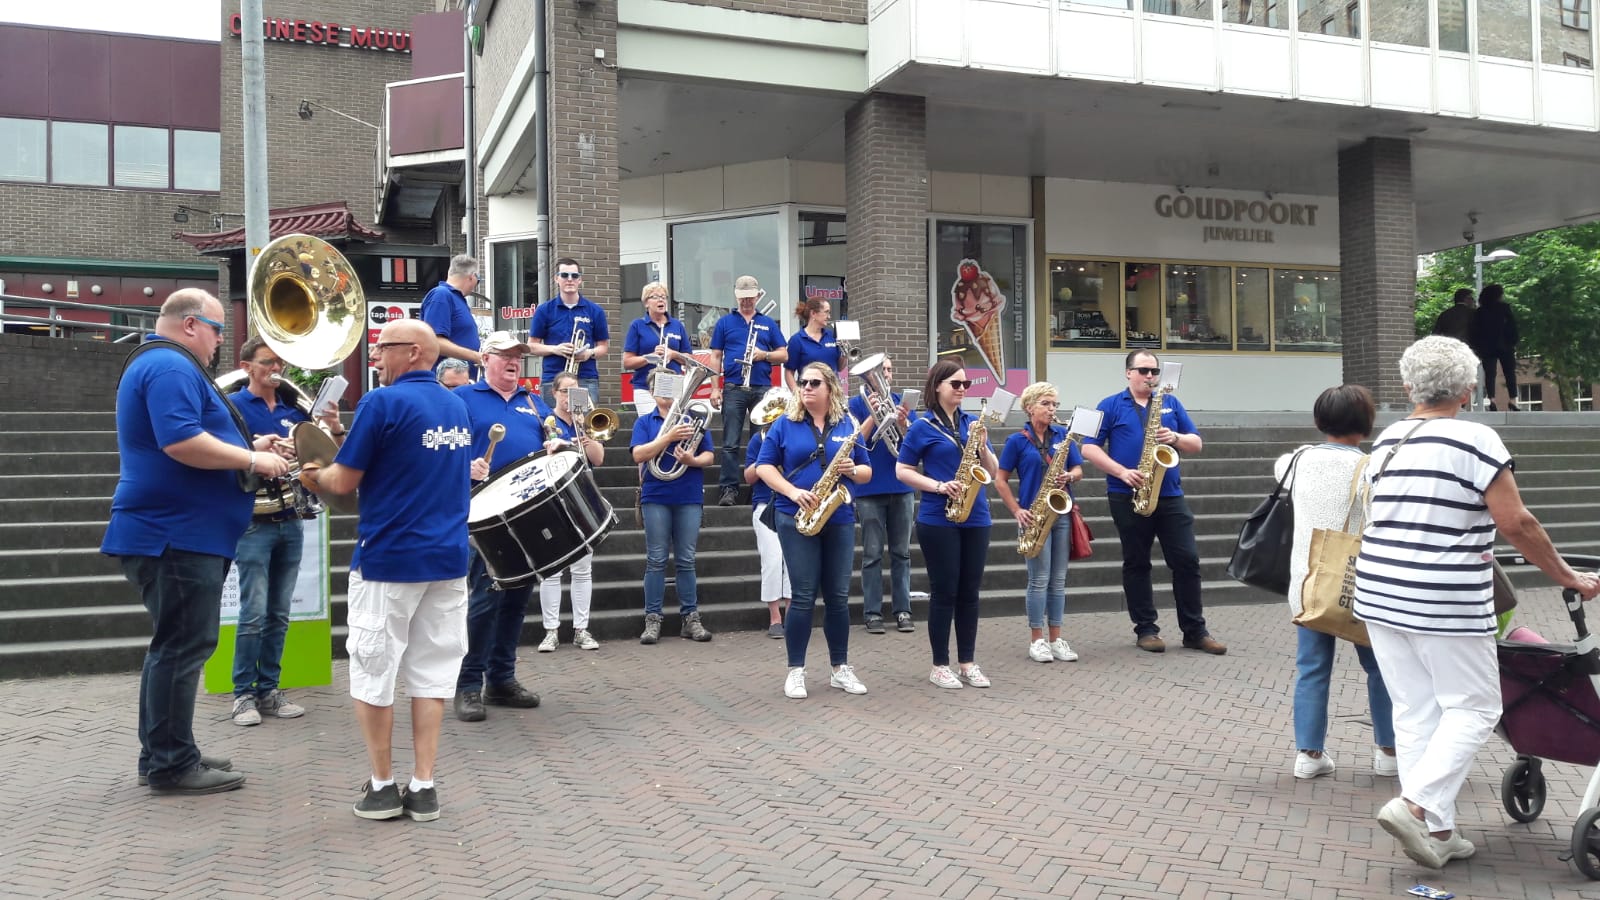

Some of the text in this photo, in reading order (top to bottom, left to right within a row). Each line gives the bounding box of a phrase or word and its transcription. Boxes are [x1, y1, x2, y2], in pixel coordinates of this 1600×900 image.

[229, 13, 339, 44] CINESE
[1154, 193, 1319, 227] GOUDPOORT
[1203, 225, 1275, 244] JUWELIER
[805, 284, 843, 300] Umai
[371, 310, 404, 320] tapAsia
[501, 303, 536, 320] Umai
[1013, 310, 1023, 342] Umai
